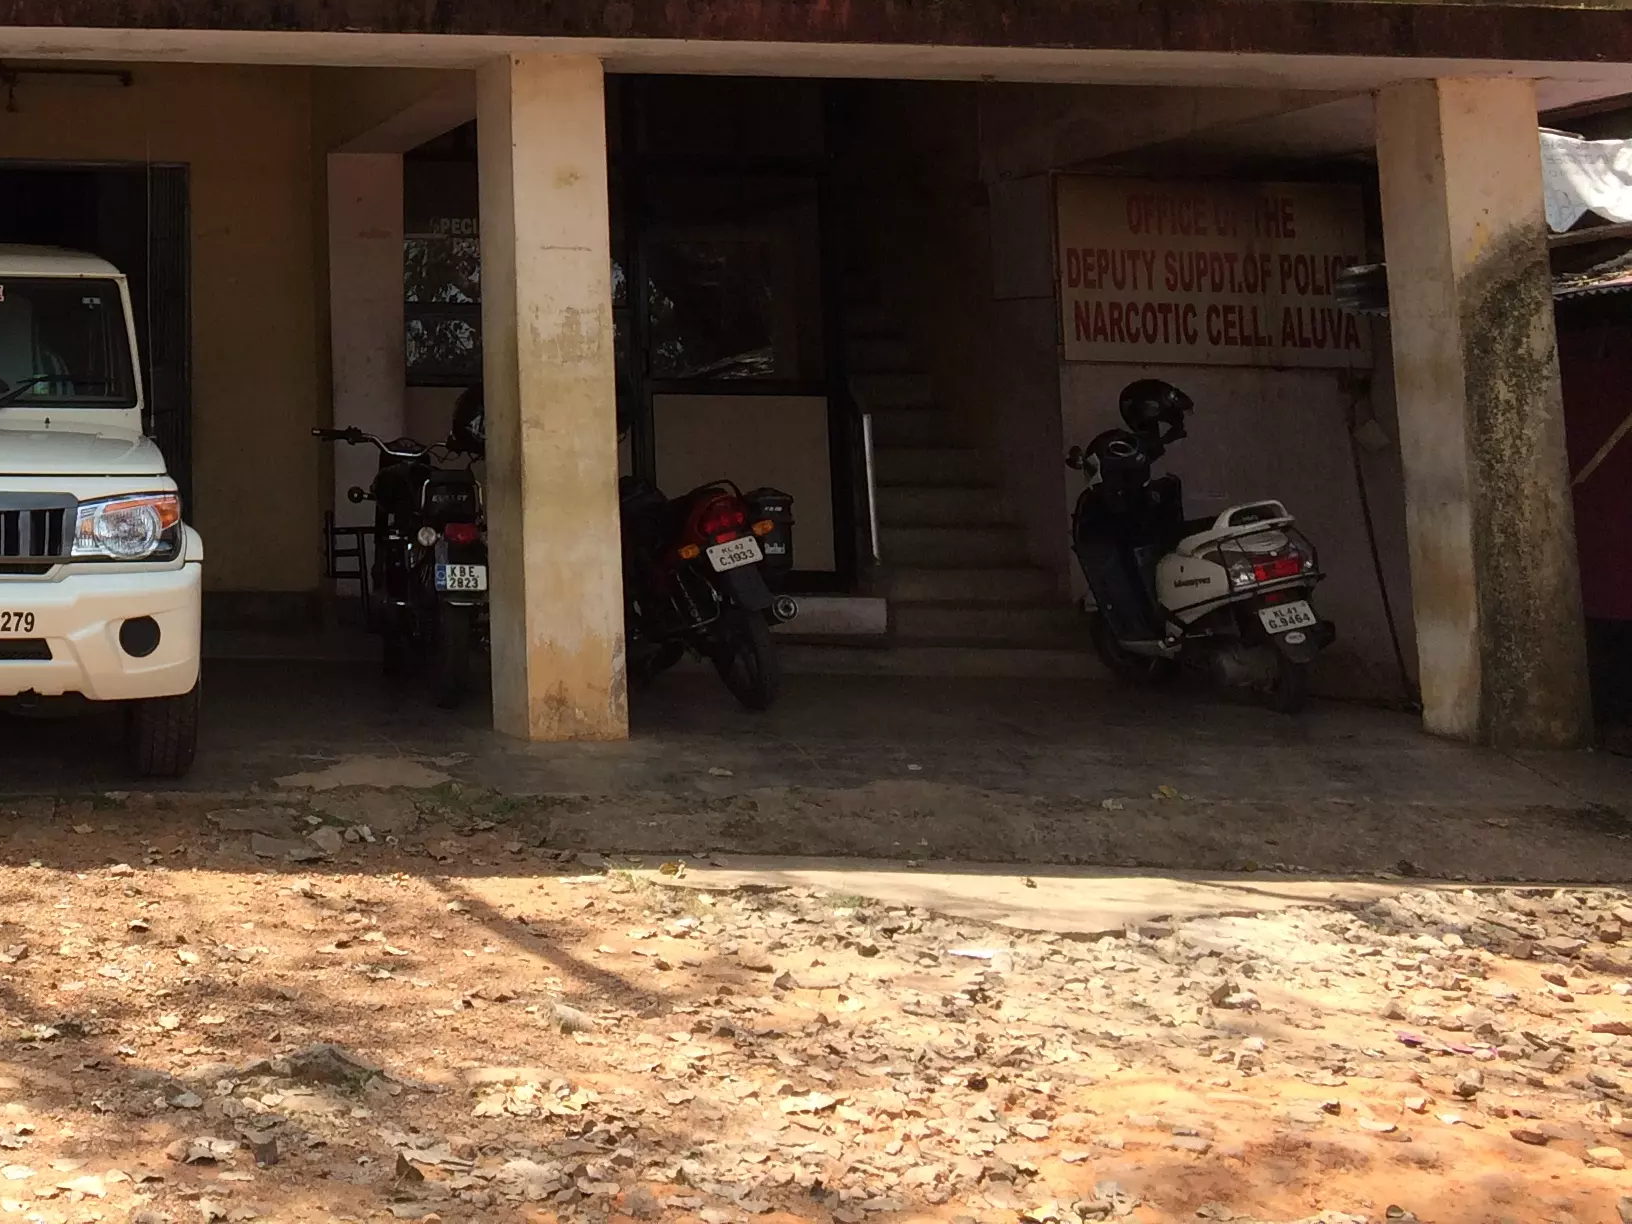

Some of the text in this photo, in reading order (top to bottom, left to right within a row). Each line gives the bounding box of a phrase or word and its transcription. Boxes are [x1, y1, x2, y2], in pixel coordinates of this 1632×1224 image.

[1067, 247, 1157, 291] DEPUTY
[1073, 300, 1199, 346] NARCOTIC
[1280, 306, 1362, 351] ALUVA
